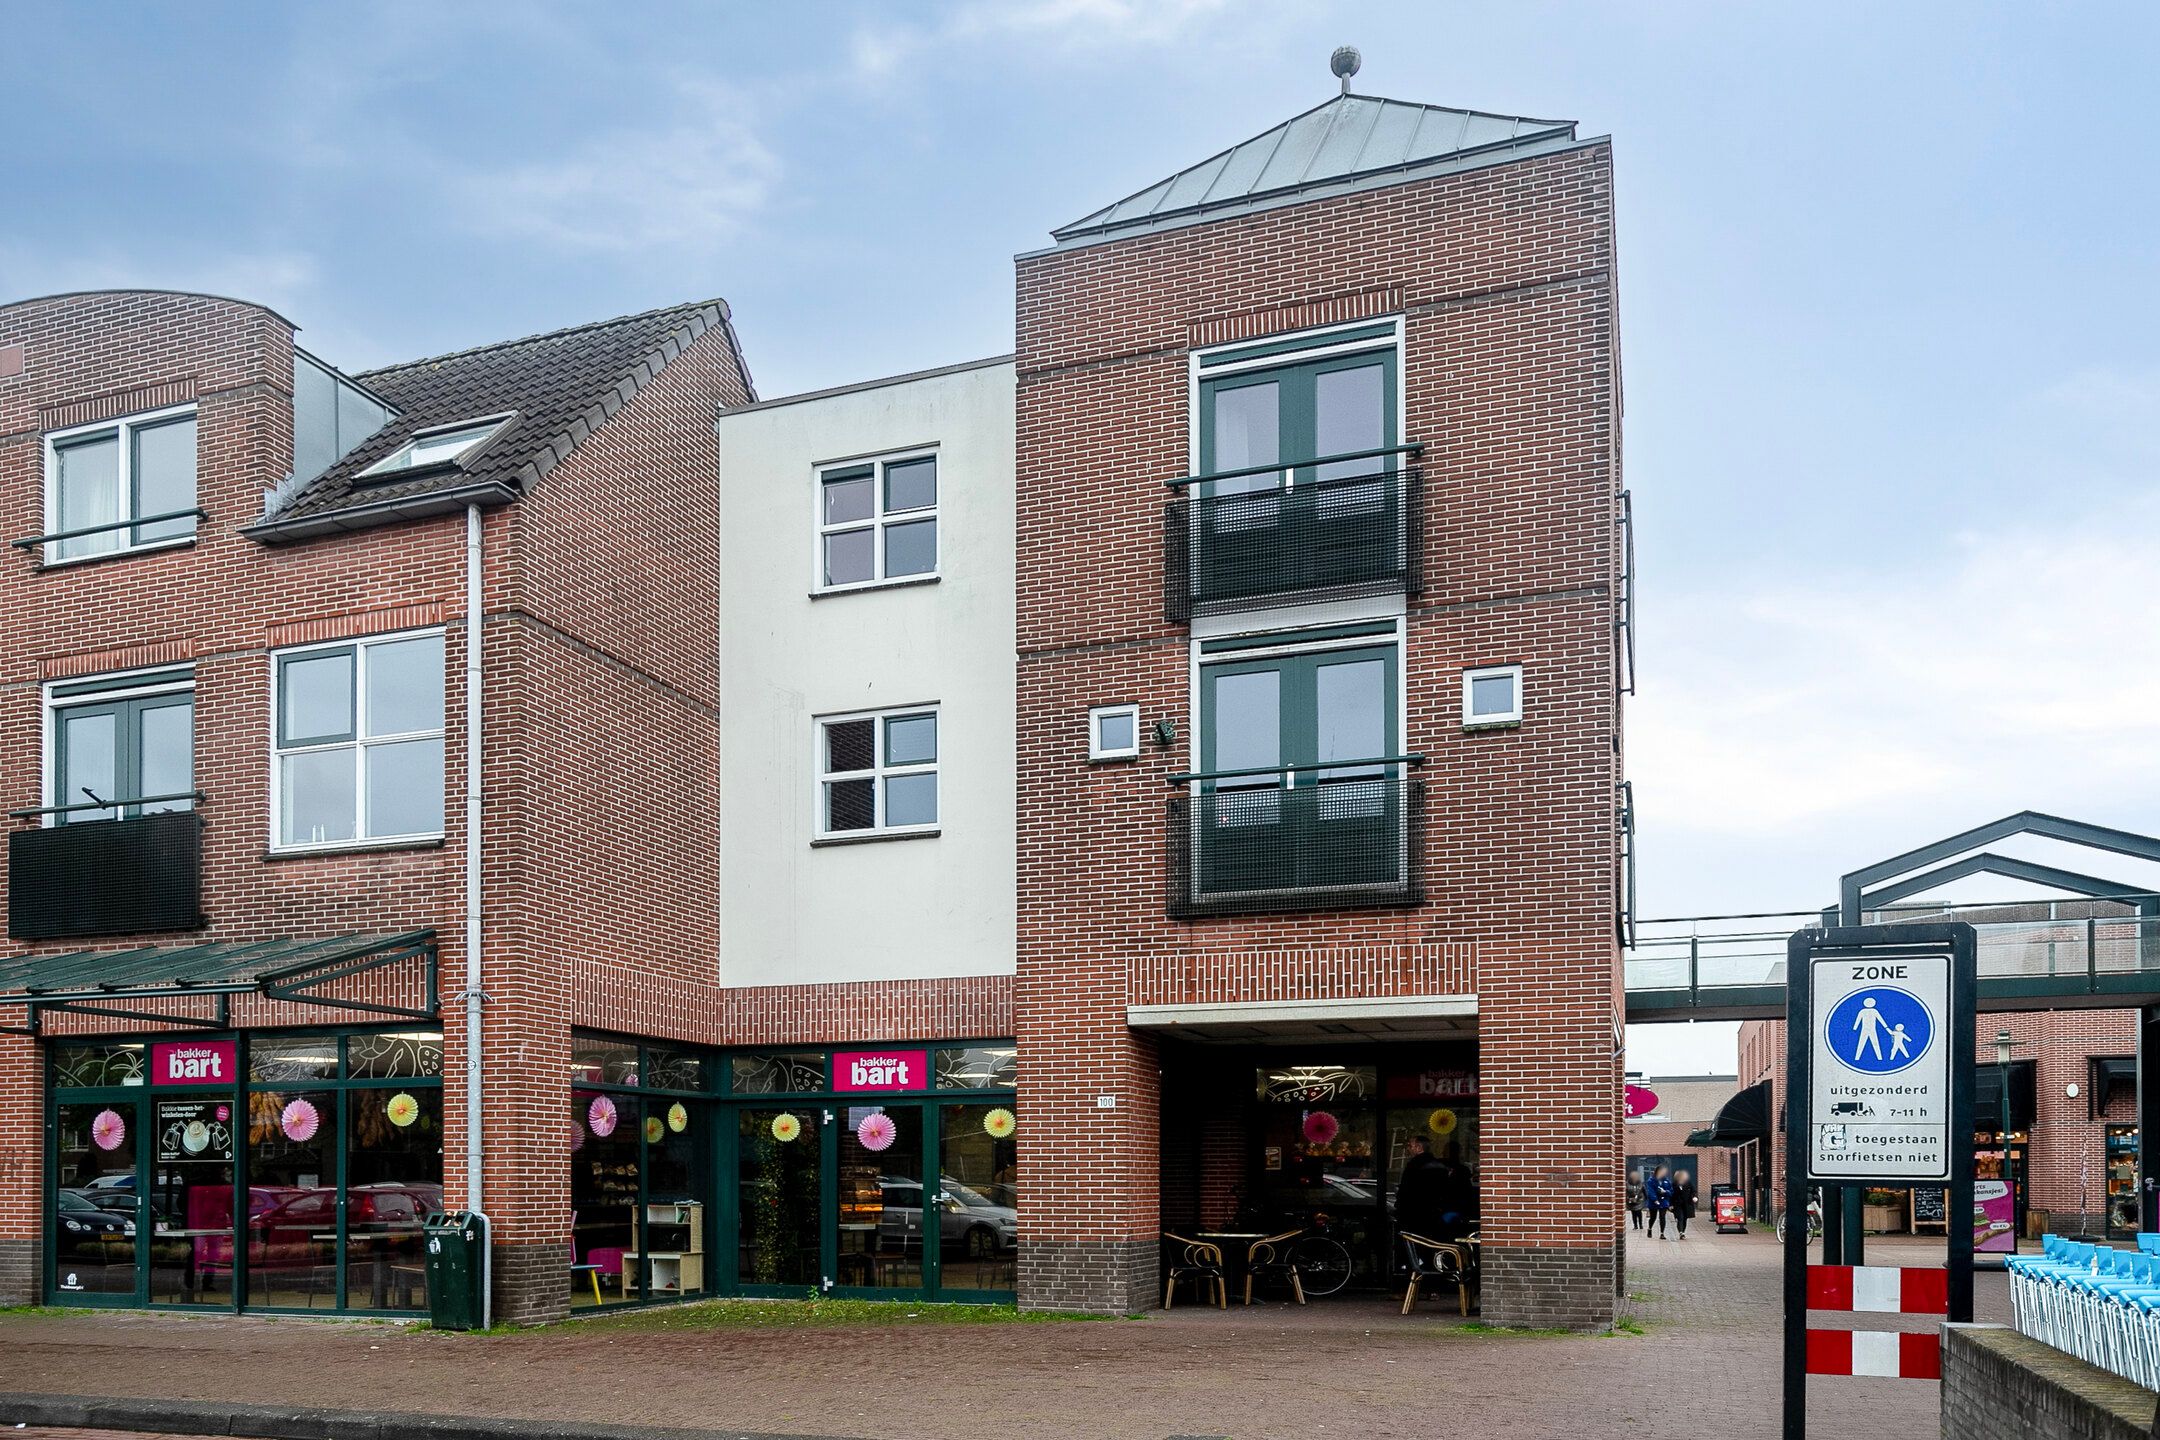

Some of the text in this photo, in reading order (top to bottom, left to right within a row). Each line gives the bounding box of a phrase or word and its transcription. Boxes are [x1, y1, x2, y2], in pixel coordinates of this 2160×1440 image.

[1852, 965, 1908, 980] ZONE
[177, 1048, 211, 1058] bakker
[169, 1052, 222, 1078] bart
[860, 1057, 898, 1067] bakker
[851, 1061, 909, 1086] bart
[1428, 1069, 1465, 1078] bakker
[1830, 1085, 1928, 1097] uitgezonderd
[1100, 1097, 1113, 1106] 100
[1920, 1107, 1928, 1116] h
[1855, 1135, 1937, 1146] toegestaan
[1819, 1152, 1938, 1162] snorfietsen niet
